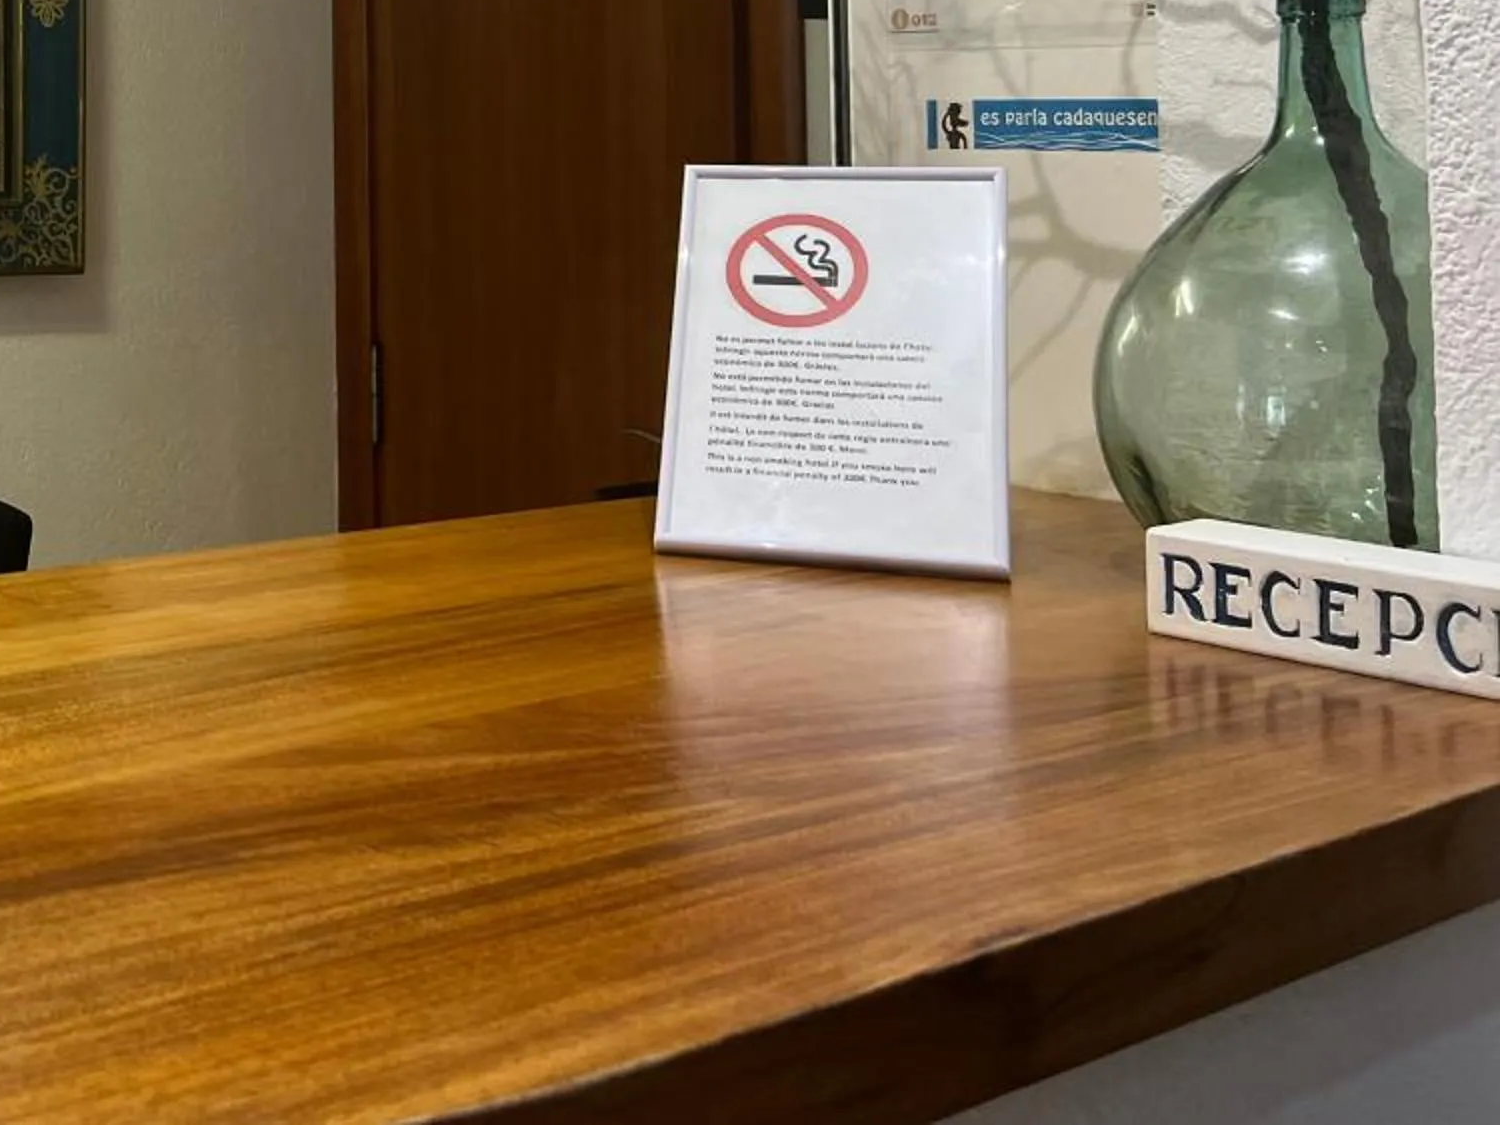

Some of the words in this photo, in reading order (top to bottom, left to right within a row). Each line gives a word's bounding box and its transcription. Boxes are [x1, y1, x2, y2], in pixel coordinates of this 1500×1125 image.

[980, 112, 998, 125] es
[1005, 108, 1047, 126] parla
[1159, 552, 1500, 677] RECEPC
